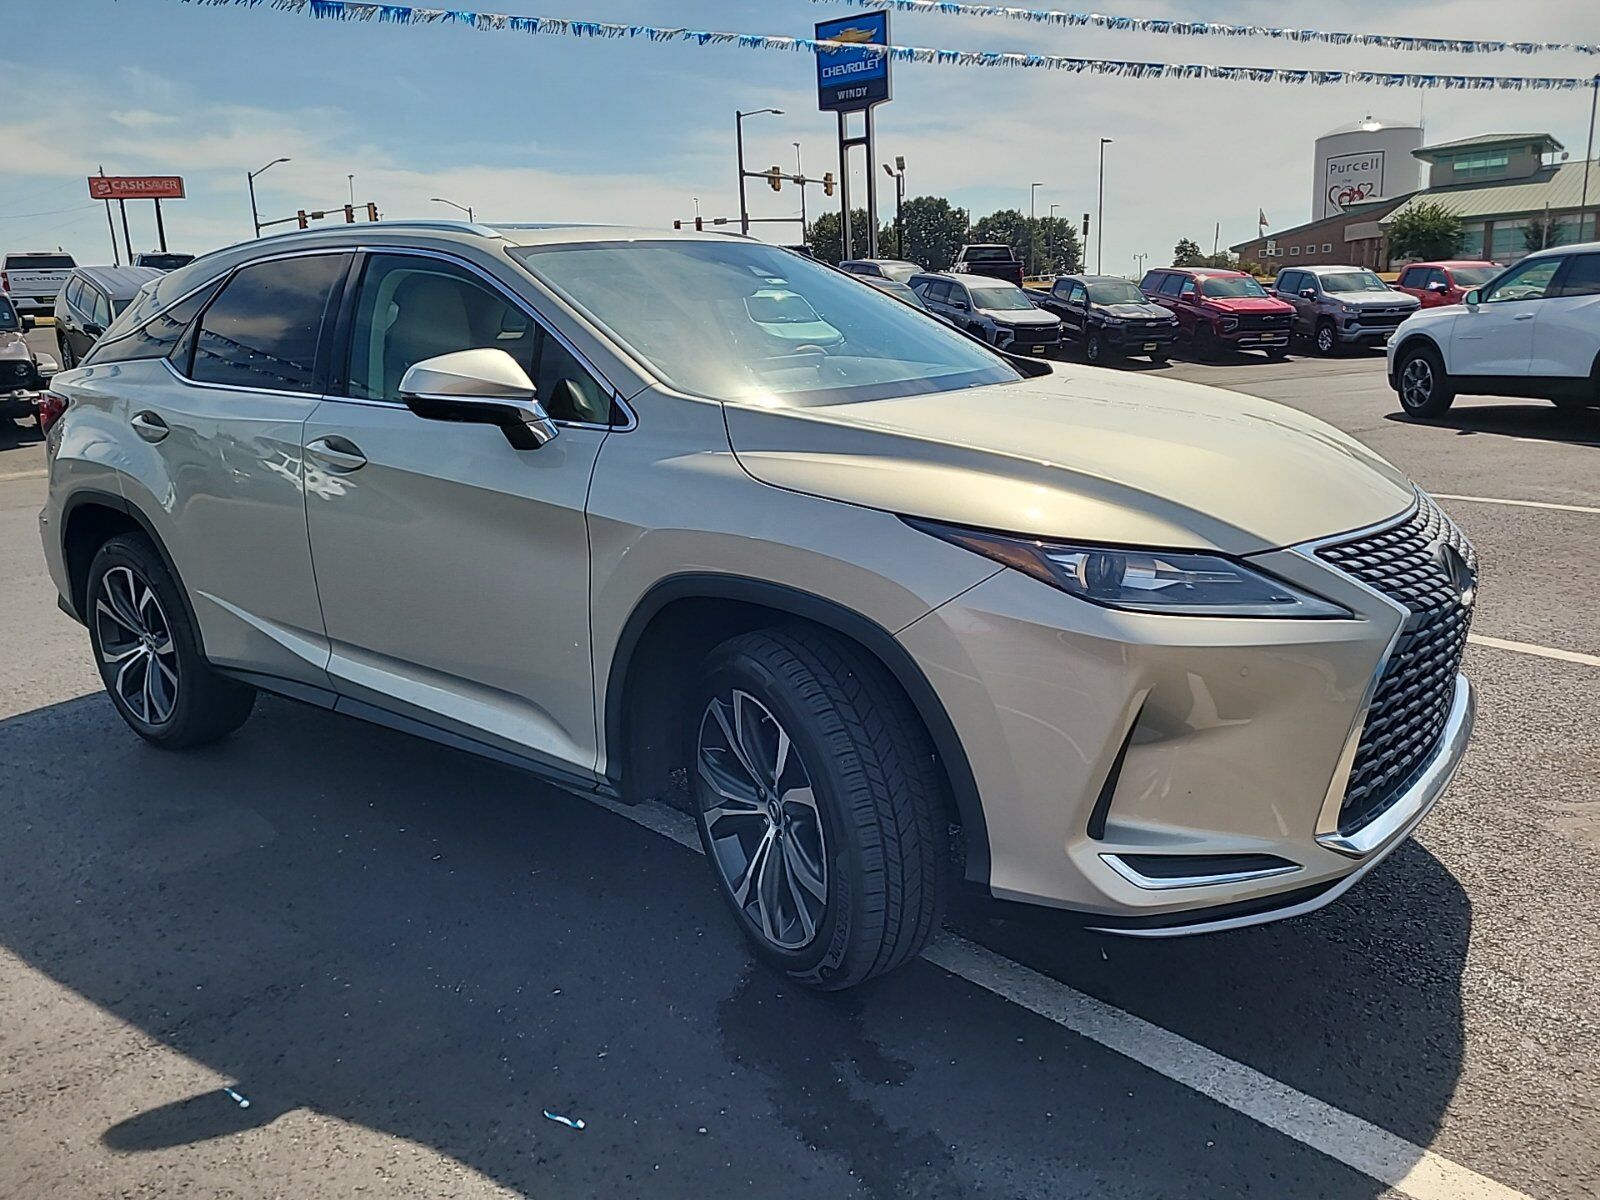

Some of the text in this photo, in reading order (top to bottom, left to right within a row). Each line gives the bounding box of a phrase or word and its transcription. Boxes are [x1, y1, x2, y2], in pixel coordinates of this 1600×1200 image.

[822, 59, 879, 78] CHEVROLET
[837, 87, 868, 100] WINDY
[1330, 158, 1379, 174] Purcell
